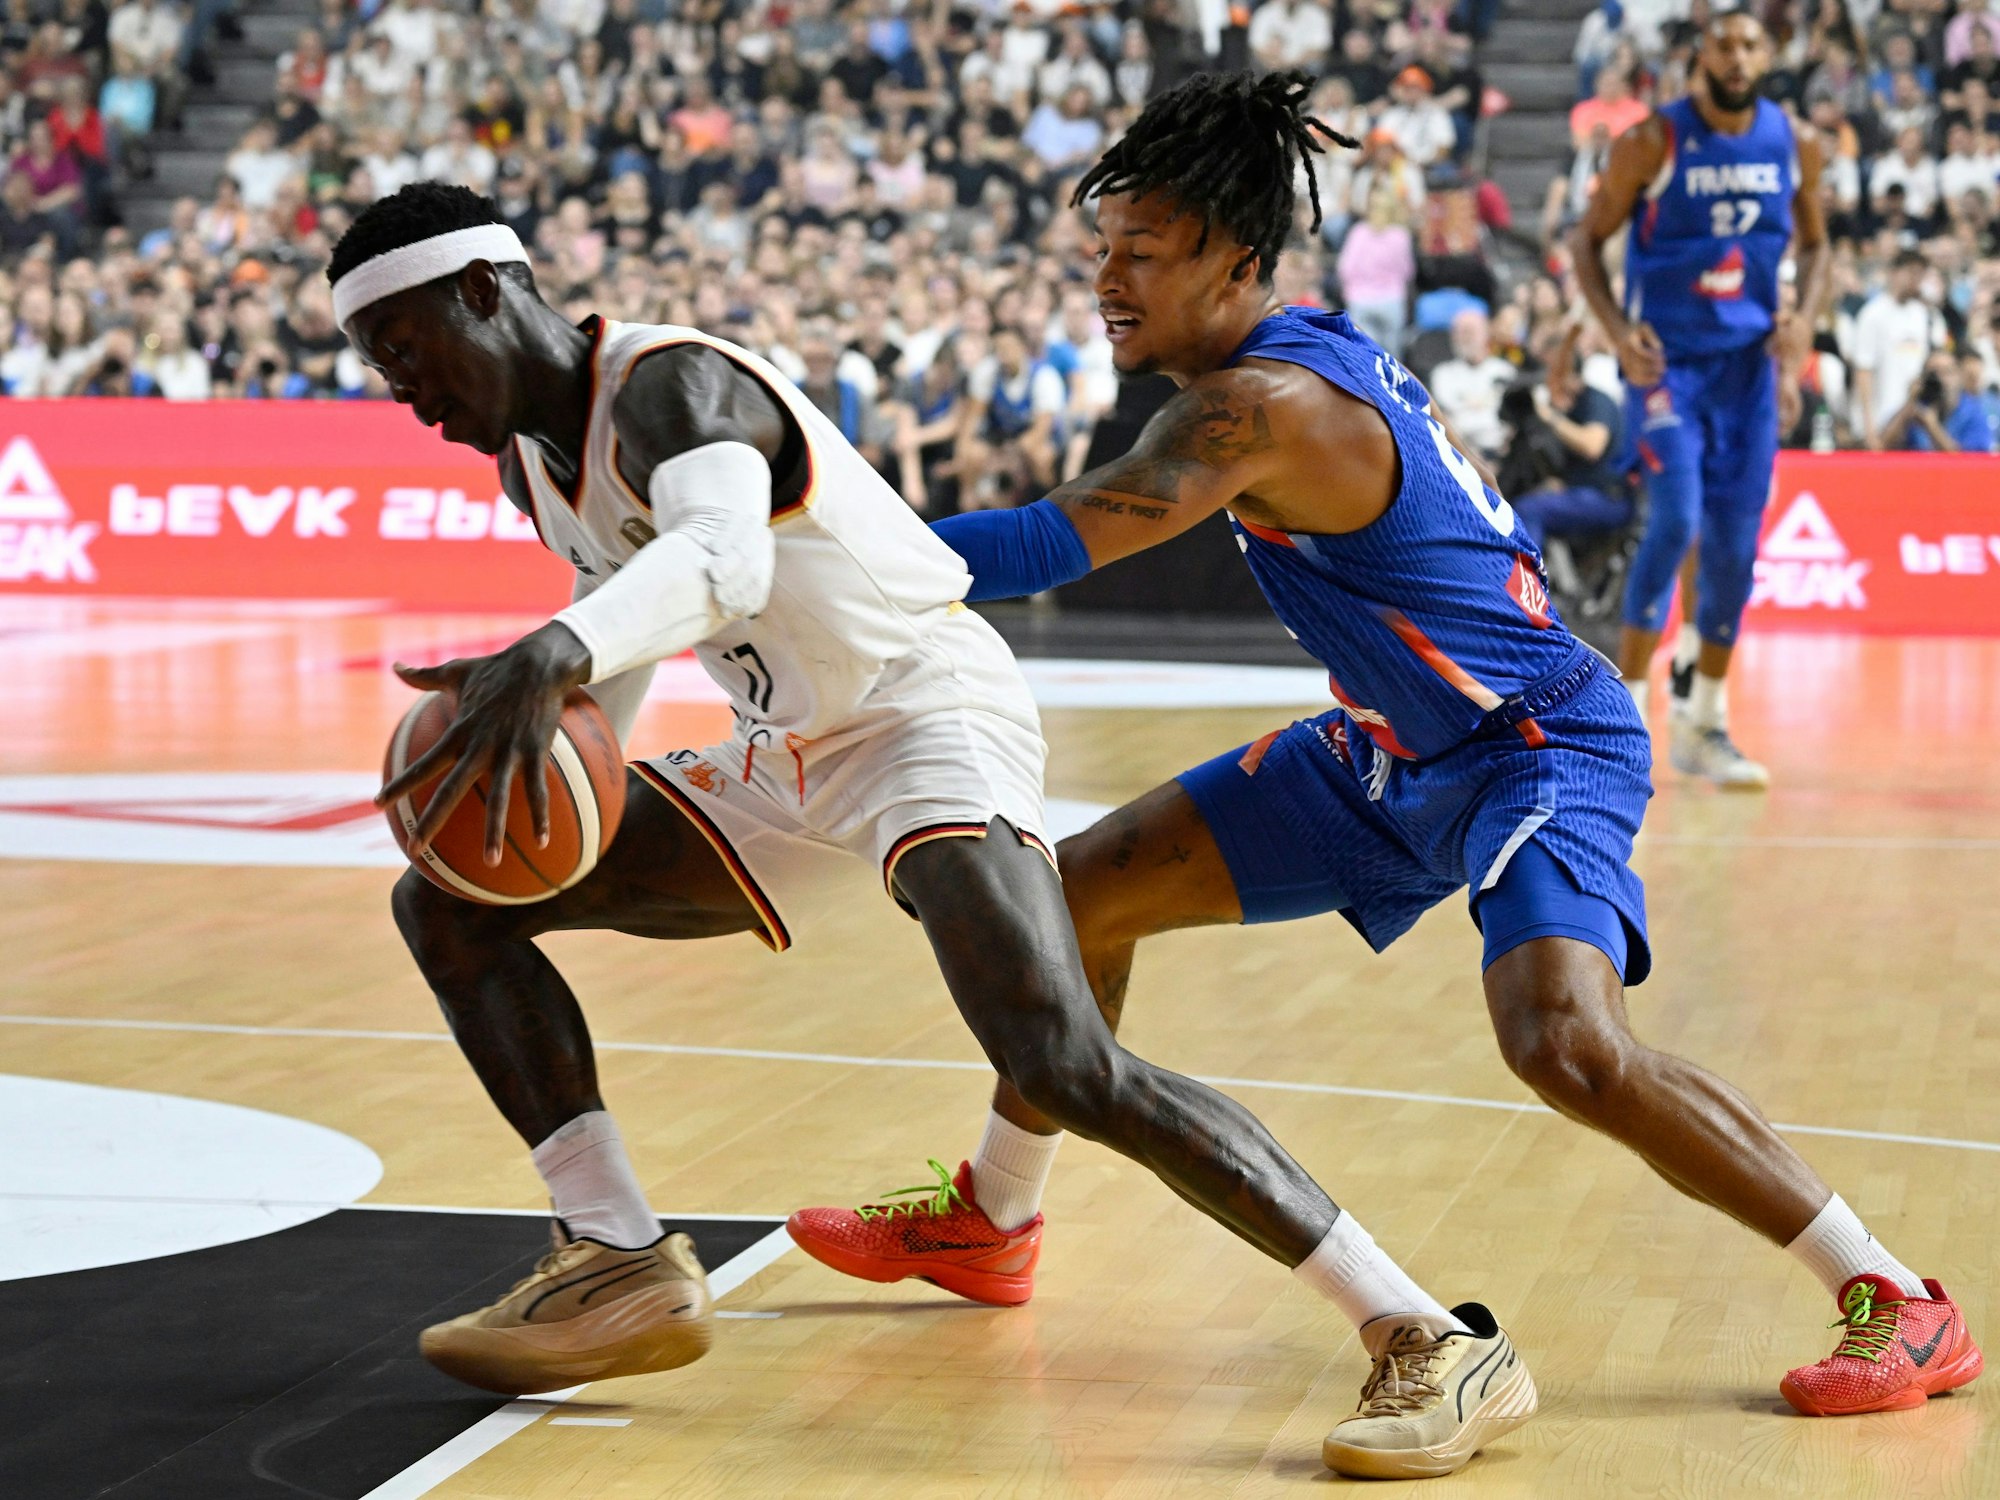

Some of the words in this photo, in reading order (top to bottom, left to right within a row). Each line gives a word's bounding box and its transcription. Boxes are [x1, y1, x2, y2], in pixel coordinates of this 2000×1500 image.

[1685, 163, 1781, 198] FRANCE
[1710, 199, 1762, 238] 27
[0, 521, 100, 583] EAK
